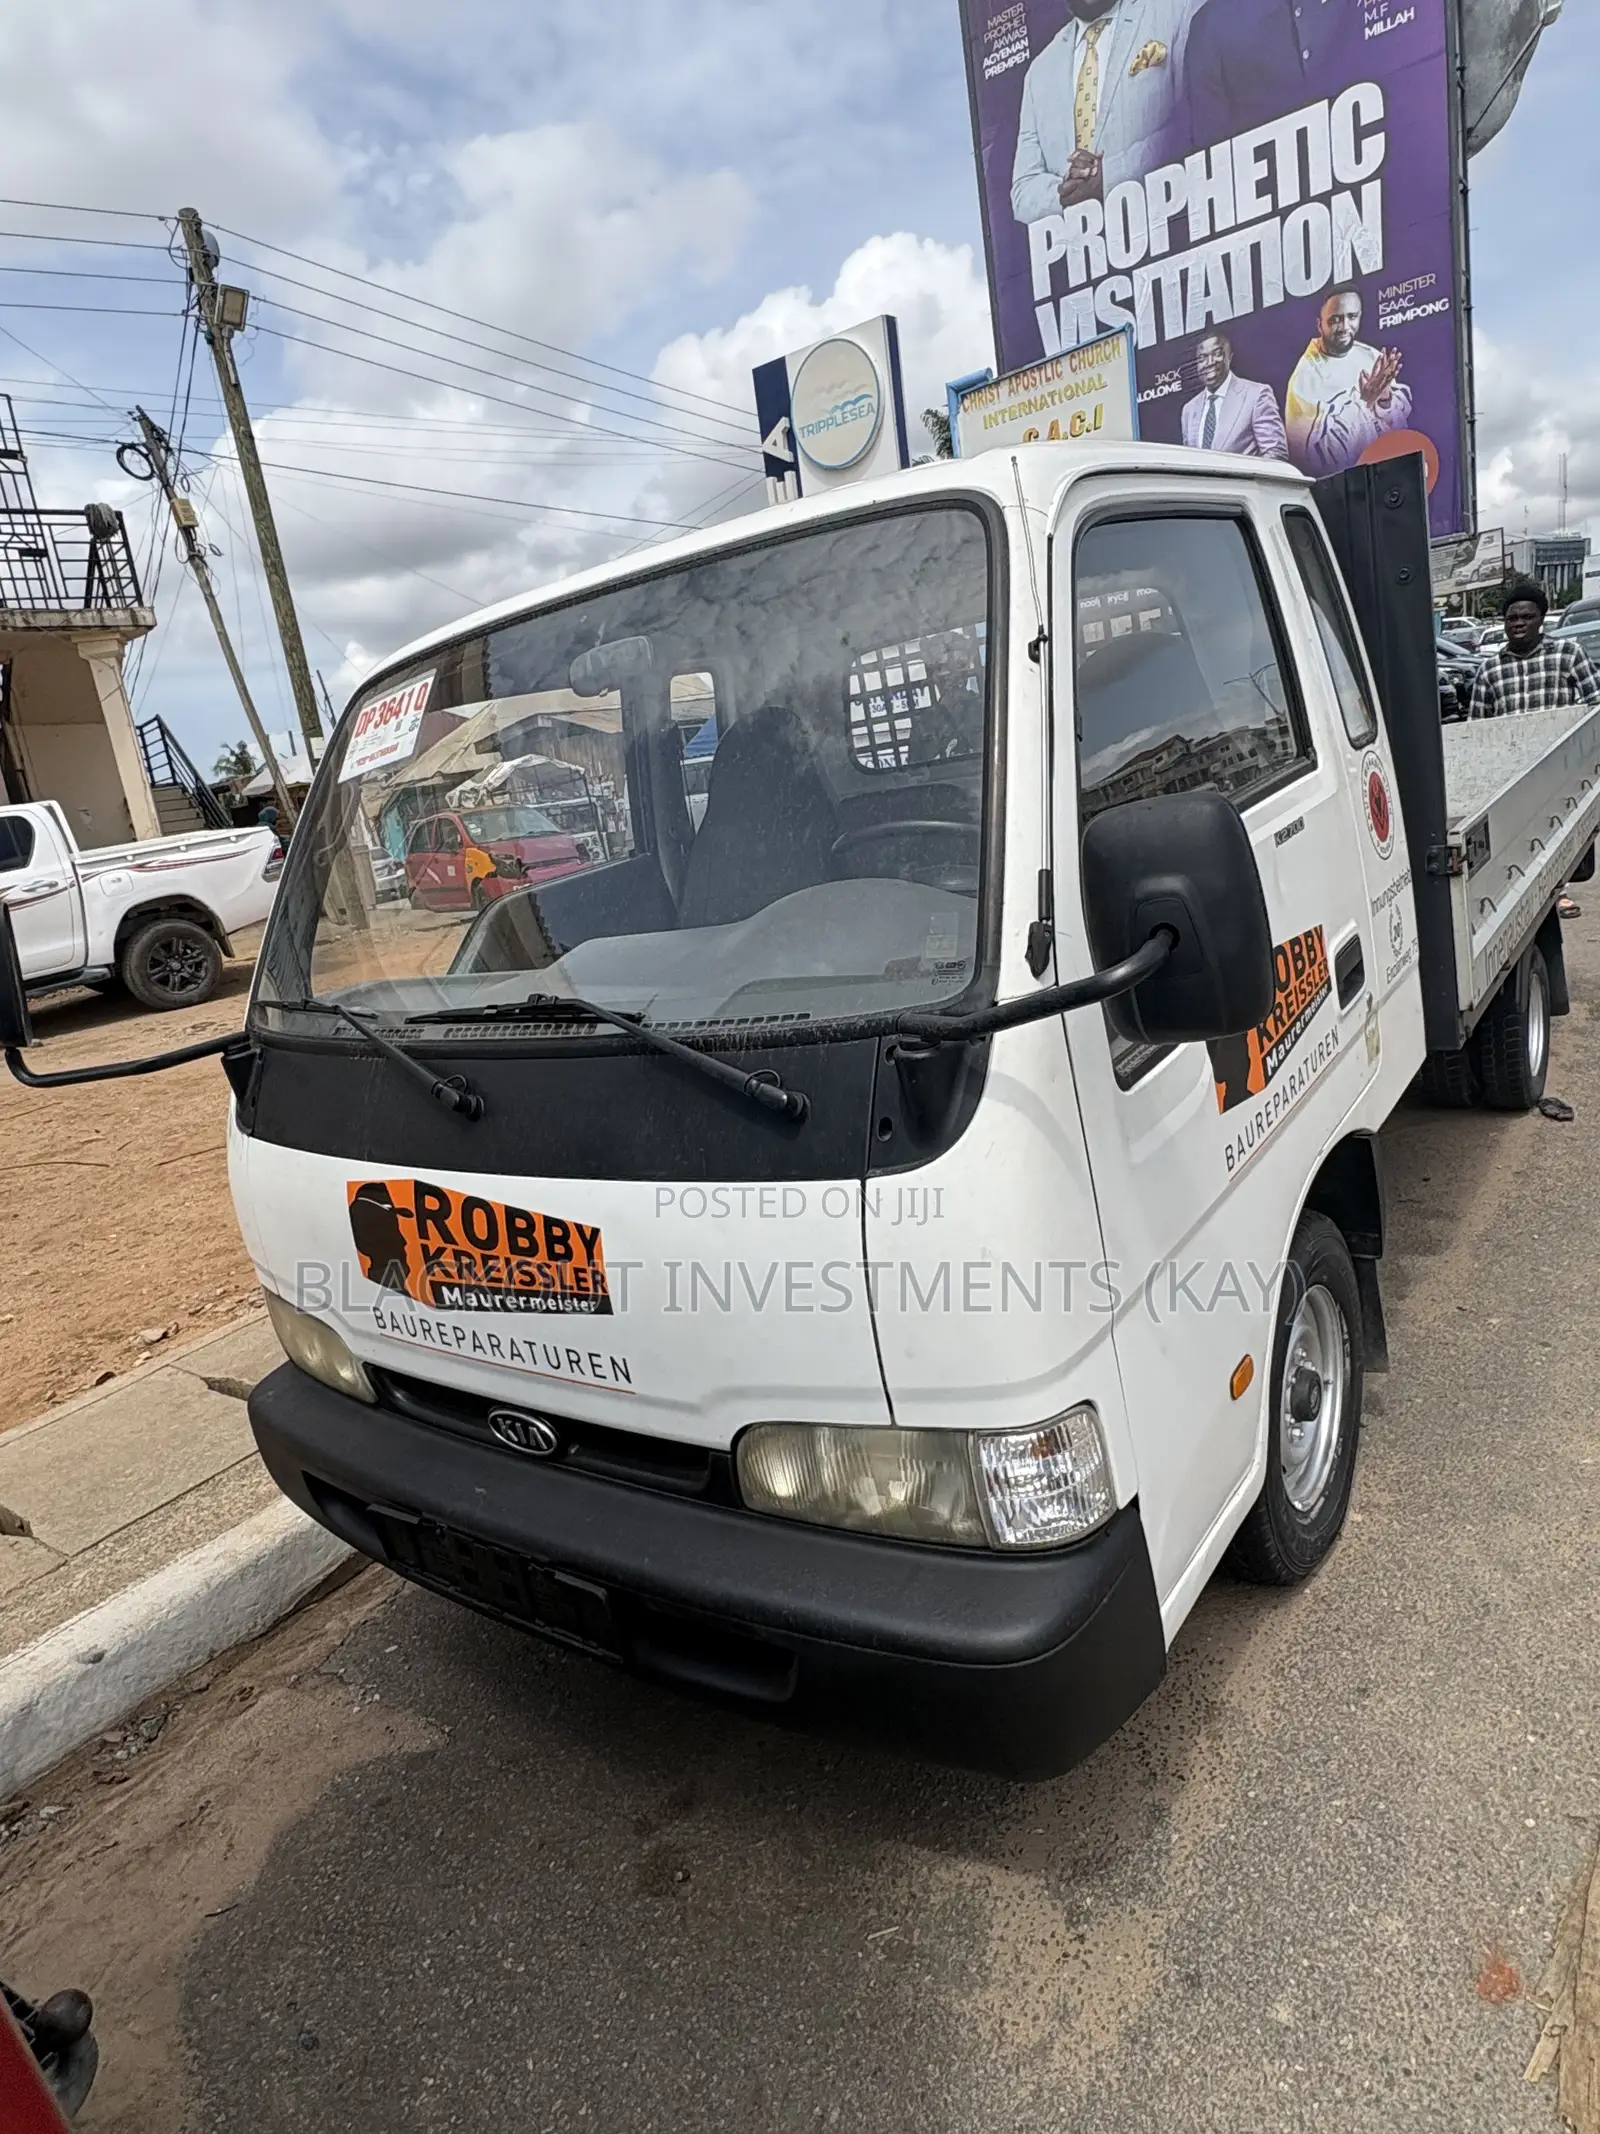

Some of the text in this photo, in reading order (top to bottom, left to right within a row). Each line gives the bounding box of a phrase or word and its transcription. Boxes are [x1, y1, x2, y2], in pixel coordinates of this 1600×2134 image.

[984, 13, 1026, 43] PROPHET
[988, 3, 1024, 30] MASTER
[1365, 7, 1415, 40] MILLAH
[983, 37, 1028, 69] AGYEMAN
[993, 26, 1028, 52] AKWASI
[985, 49, 1030, 80] PREMPEH
[1028, 82, 1385, 301] PROPHETIC
[1035, 179, 1384, 359] VISITATION
[1379, 273, 1436, 301] MINISTER
[1379, 295, 1415, 315] ISAAC
[1379, 298, 1449, 330] FRIMPONG
[961, 337, 1122, 415] CHRIST APOSTLIC CHURCH
[1137, 381, 1182, 403] LOLOME
[1155, 368, 1181, 385] JACK
[982, 373, 1108, 430] INTERNATIONAL
[800, 402, 875, 438] TRIPPLESEA
[1274, 924, 1325, 993] OBBY
[1256, 959, 1329, 1050] KREISSLER
[1266, 983, 1328, 1076] Maurermeister
[1225, 1025, 1339, 1173] BAUREPARATUREN
[413, 1179, 601, 1270] ROBBY
[420, 1243, 608, 1294] KREISSLER
[441, 1286, 597, 1313] Maurermeister
[373, 1306, 632, 1385] BAUREPARATUREN
[495, 1414, 549, 1451] KIA
